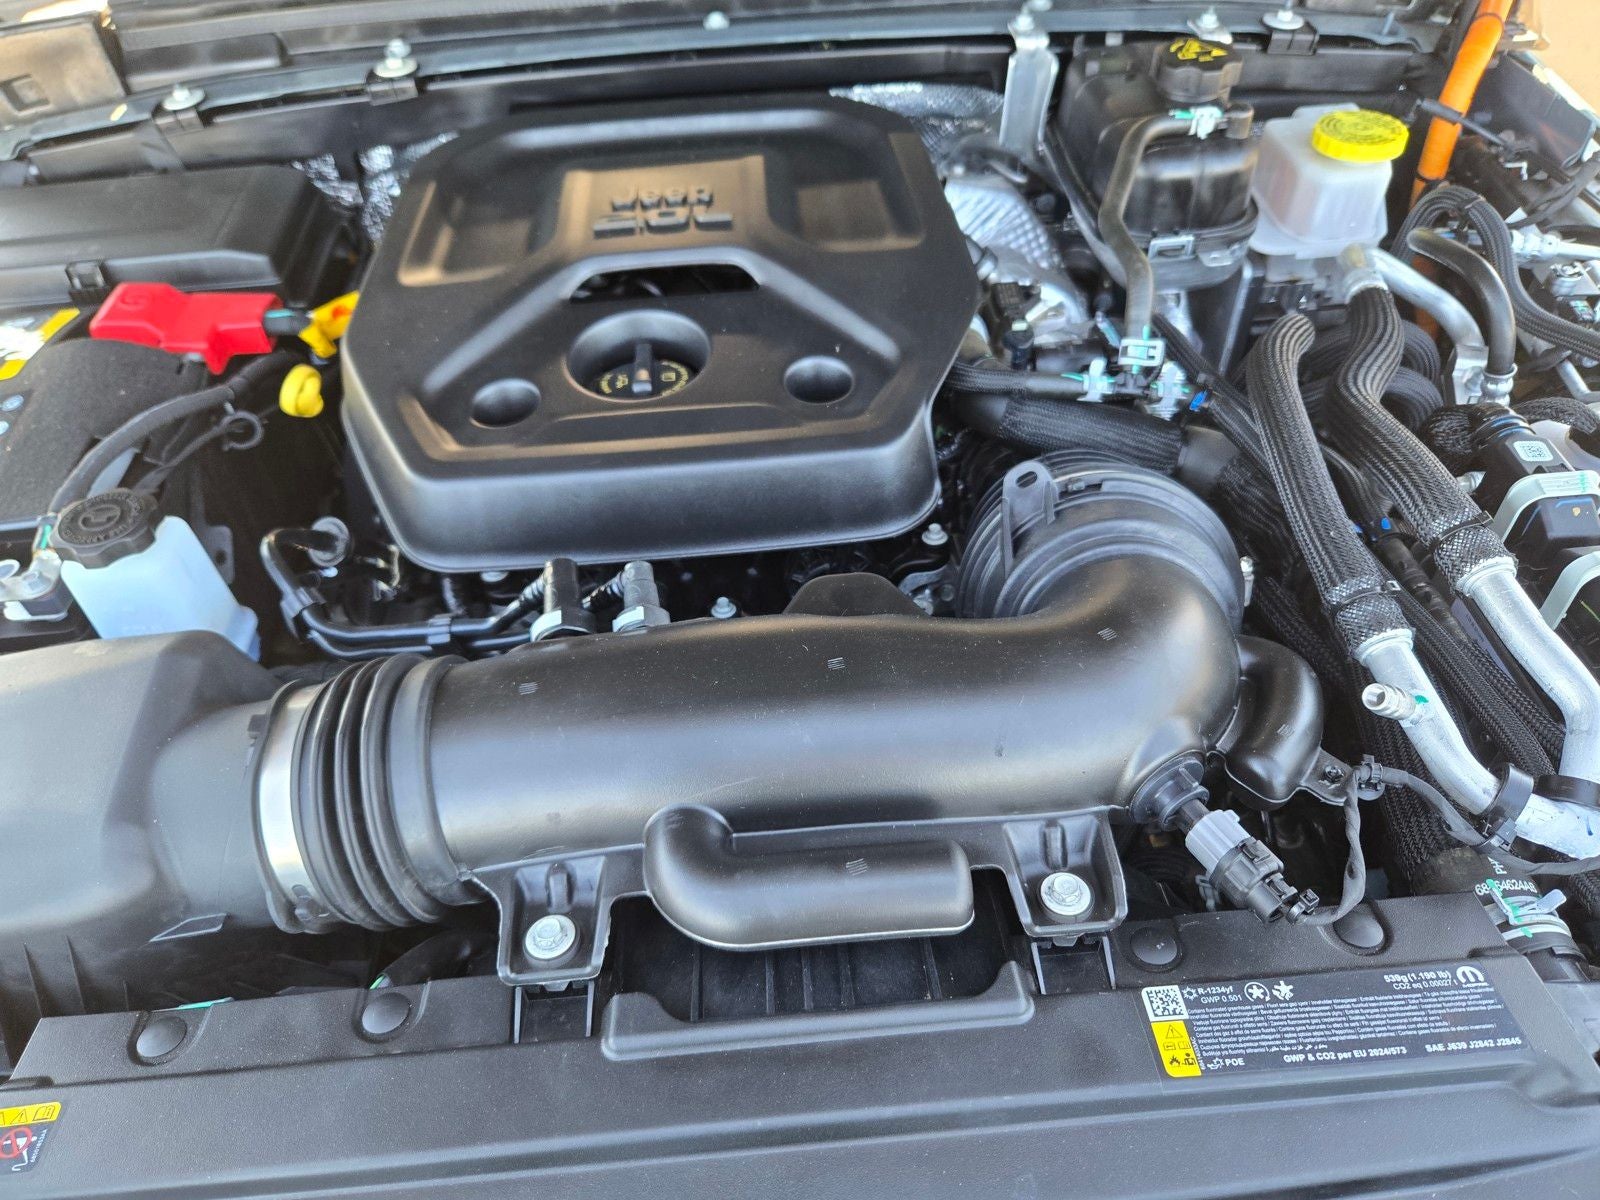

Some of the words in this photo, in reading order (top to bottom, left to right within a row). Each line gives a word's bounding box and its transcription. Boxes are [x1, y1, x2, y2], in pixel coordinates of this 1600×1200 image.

[593, 207, 733, 239] 2.0L
[1393, 982, 1411, 990] CO2
[1200, 996, 1220, 1004] GWP
[1425, 1043, 1446, 1052] SAE
[1446, 1041, 1467, 1050] J639
[1283, 1053, 1305, 1063] GWP
[1307, 1053, 1315, 1062] &
[1316, 1051, 1336, 1061] CO2
[1337, 1051, 1352, 1061] per
[1353, 1049, 1367, 1058] EU
[1225, 1058, 1245, 1067] POE
